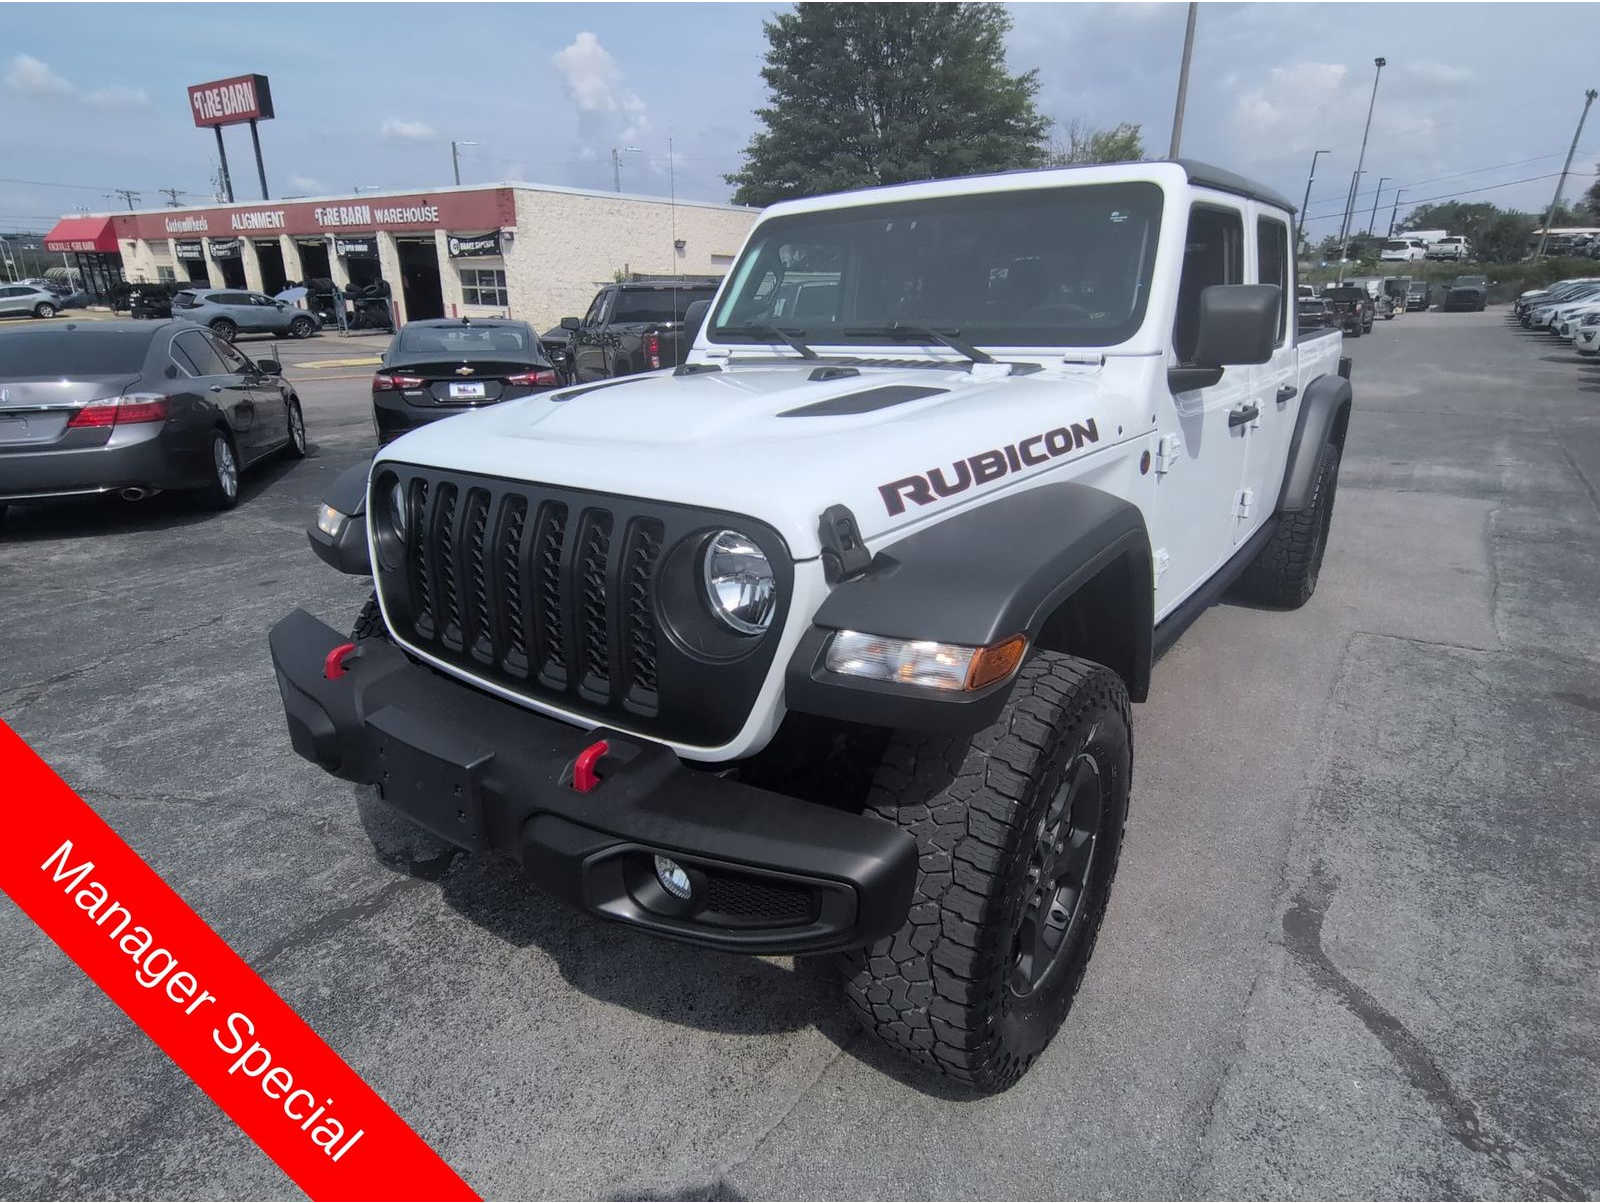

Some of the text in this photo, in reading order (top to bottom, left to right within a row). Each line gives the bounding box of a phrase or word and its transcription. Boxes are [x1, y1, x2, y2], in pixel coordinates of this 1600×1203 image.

[219, 81, 256, 116] BARN
[231, 211, 286, 230] ALIGNMENT
[339, 205, 371, 225] BARN
[374, 206, 440, 223] WAREHOUSE
[878, 417, 1099, 518] RUBICON
